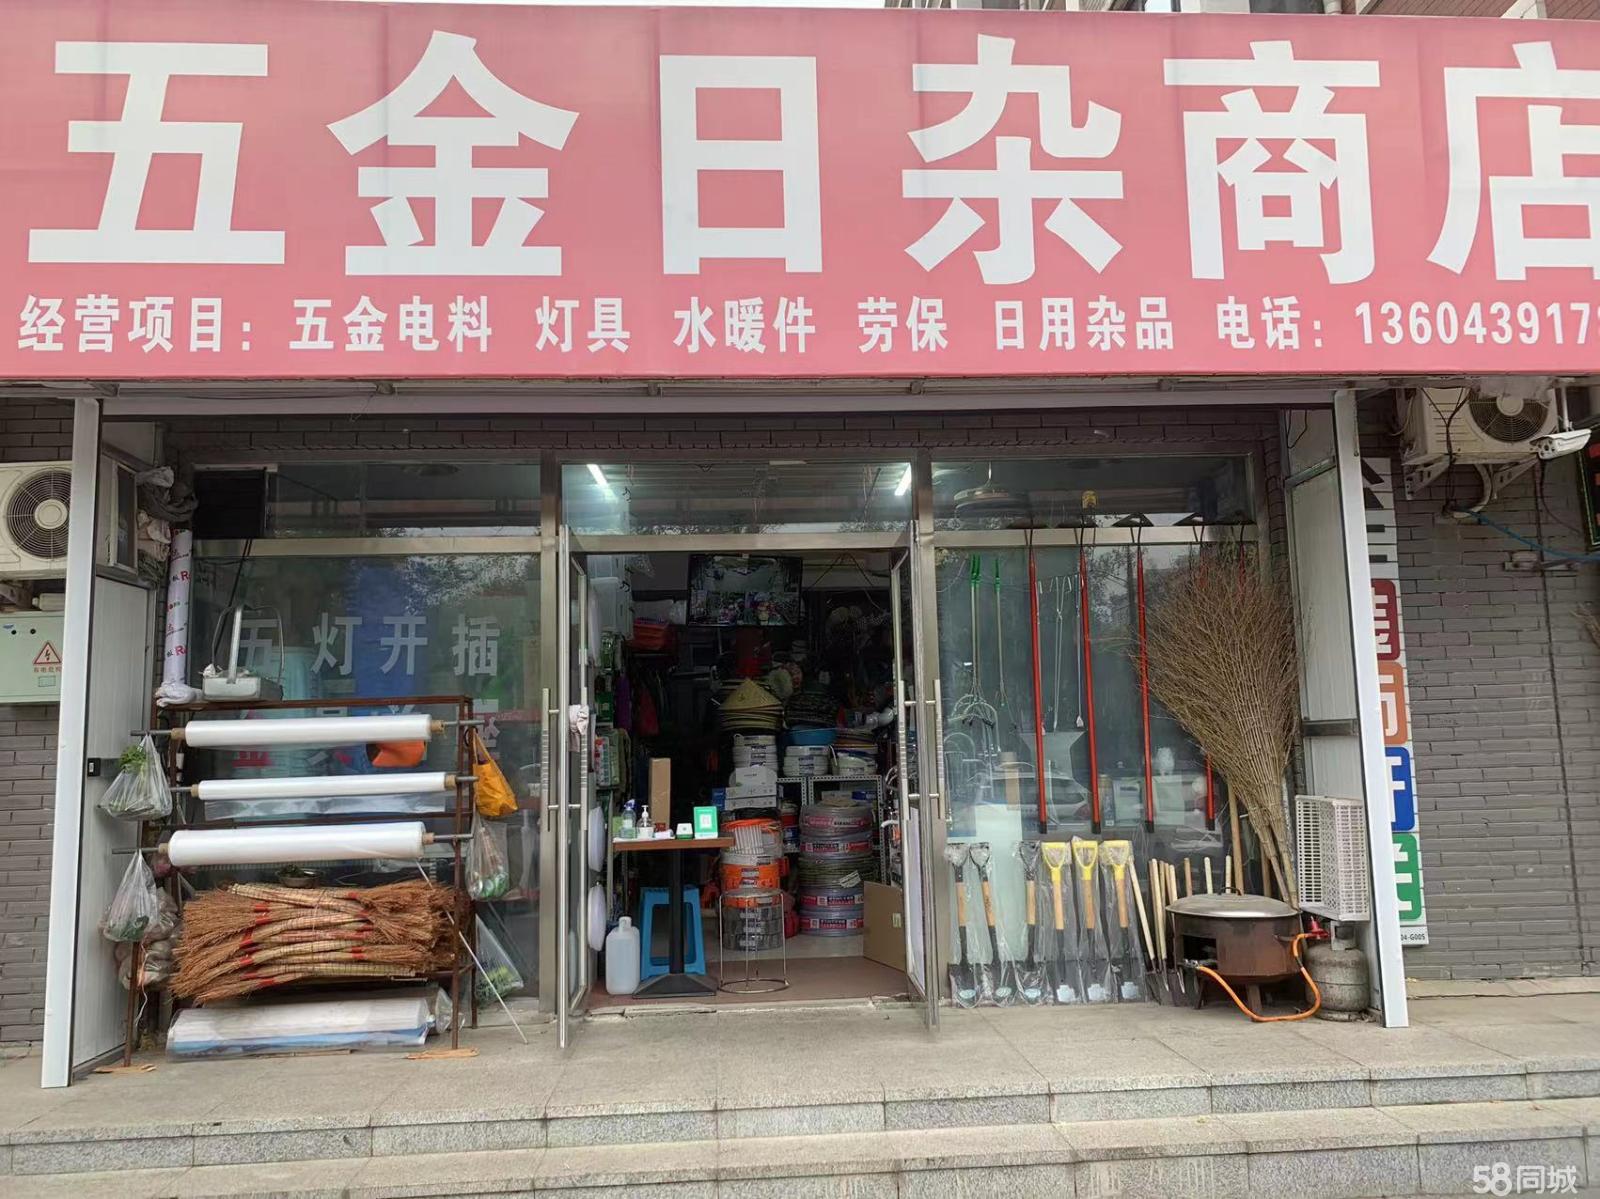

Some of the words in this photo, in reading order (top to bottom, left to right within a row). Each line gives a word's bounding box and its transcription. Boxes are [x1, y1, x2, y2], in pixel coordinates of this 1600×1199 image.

[27, 30, 1600, 286] 五金日杂商店
[289, 295, 492, 353] 五金电料
[535, 296, 630, 353] 灯具
[674, 296, 816, 355] 水暖件
[857, 295, 948, 353] 劳保
[994, 295, 1175, 351] 日用杂品
[1355, 300, 1600, 345] 136043917
